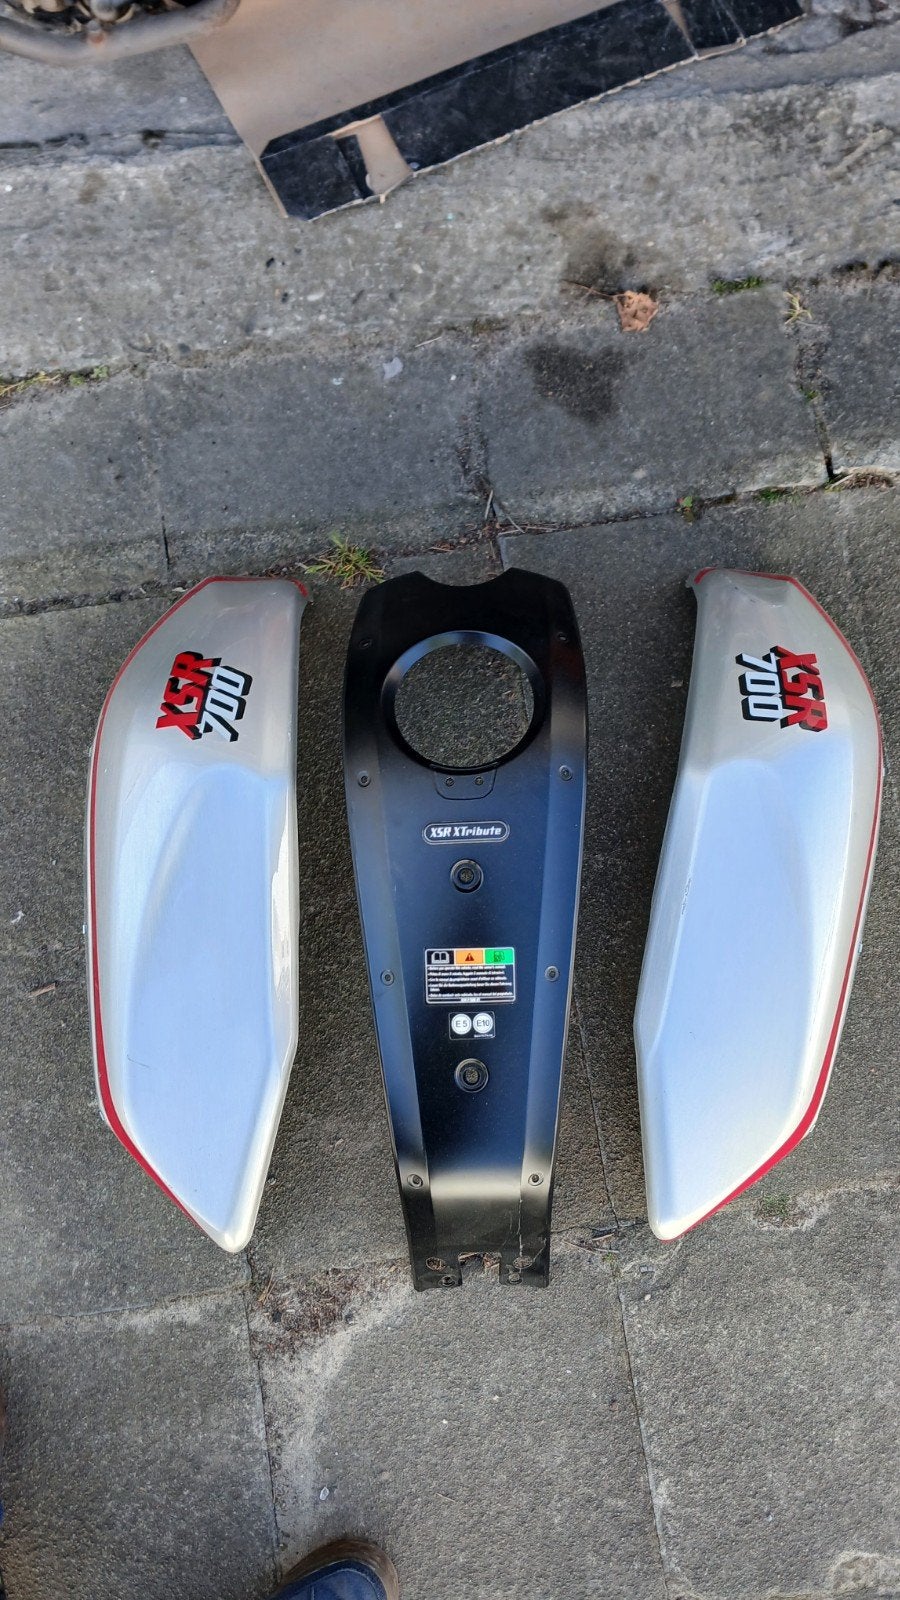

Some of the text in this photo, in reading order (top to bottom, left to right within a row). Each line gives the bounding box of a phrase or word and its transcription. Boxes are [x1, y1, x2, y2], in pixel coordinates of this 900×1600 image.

[156, 650, 222, 740] XSR
[199, 666, 253, 742] 700
[735, 652, 783, 722] 700
[770, 645, 828, 732] XSR
[429, 825, 502, 838] XSR XTribute
[476, 1019, 490, 1027] E10
